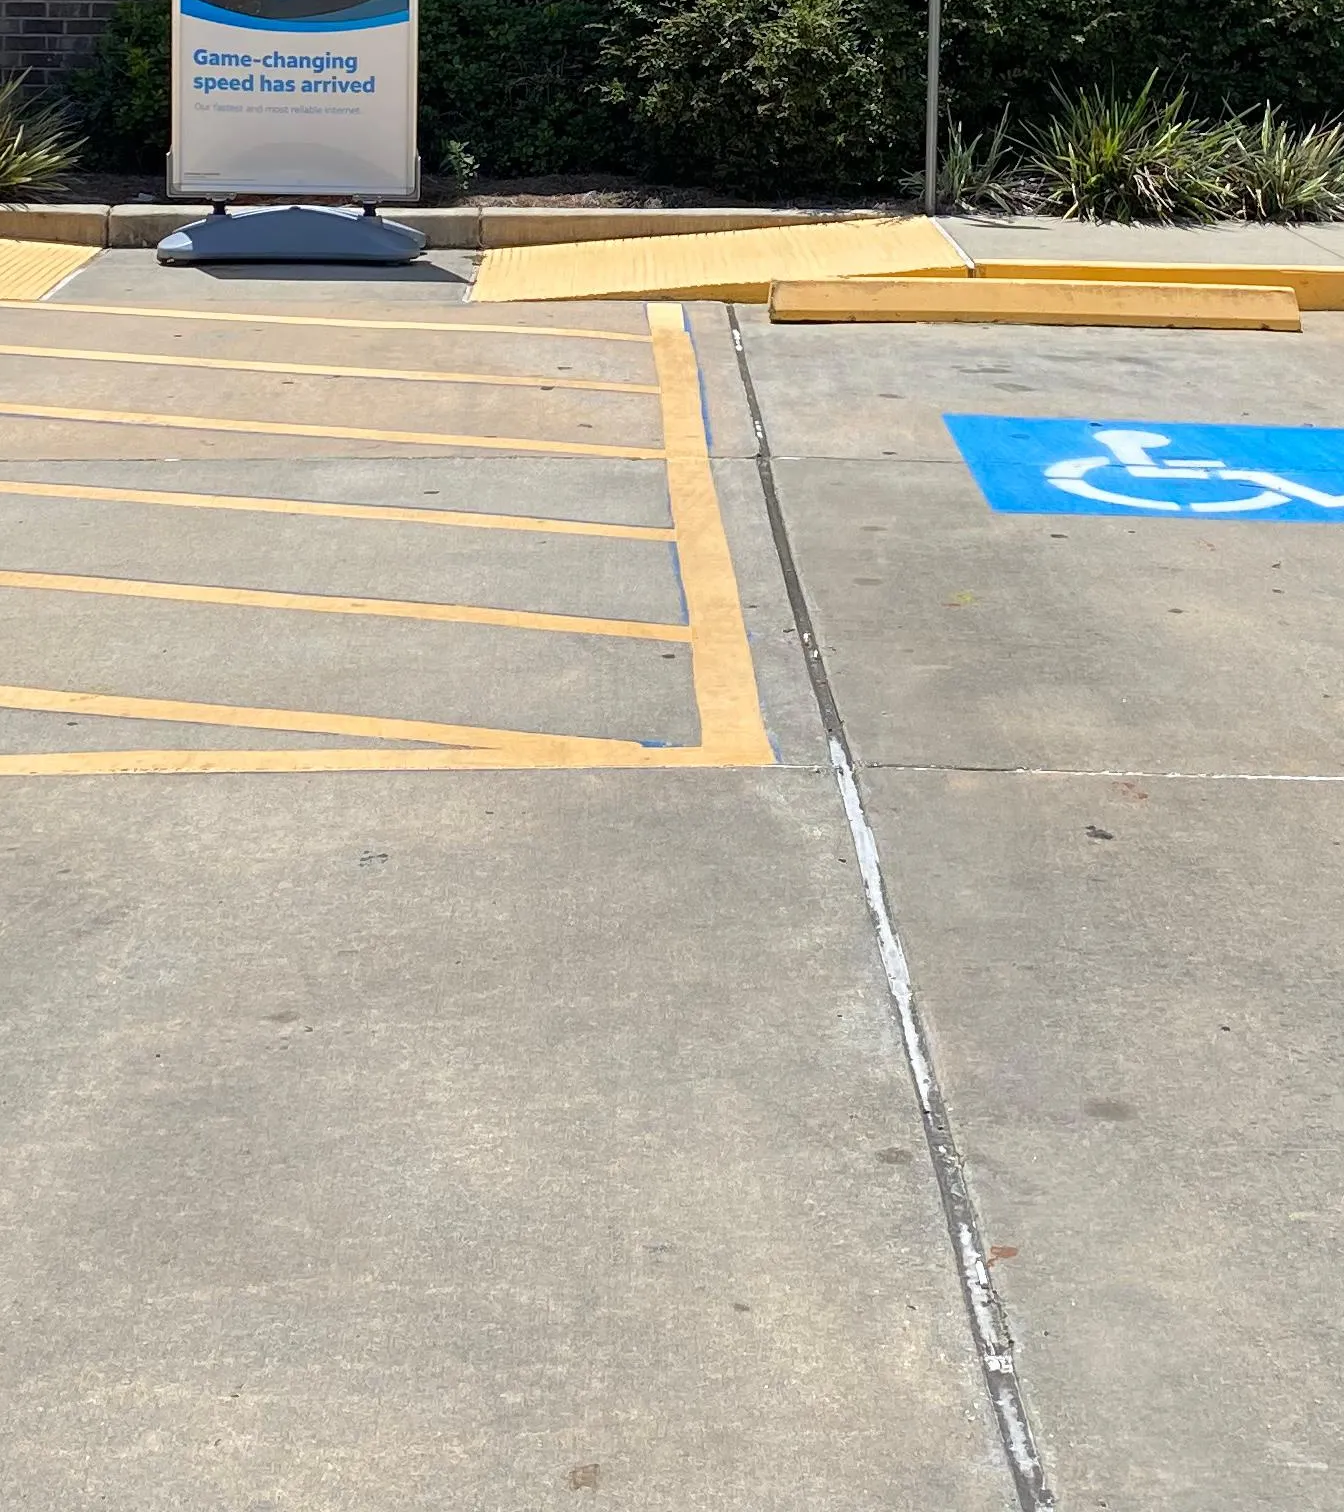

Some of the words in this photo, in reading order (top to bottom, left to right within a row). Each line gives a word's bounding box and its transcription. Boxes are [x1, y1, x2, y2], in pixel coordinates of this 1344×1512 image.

[193, 48, 358, 74] Game-changing
[193, 74, 254, 94] speed
[260, 75, 296, 92] has
[301, 76, 376, 94] arrived
[194, 101, 211, 112] Our
[246, 104, 263, 114] and
[265, 105, 289, 114] most
[291, 105, 323, 115] reliable
